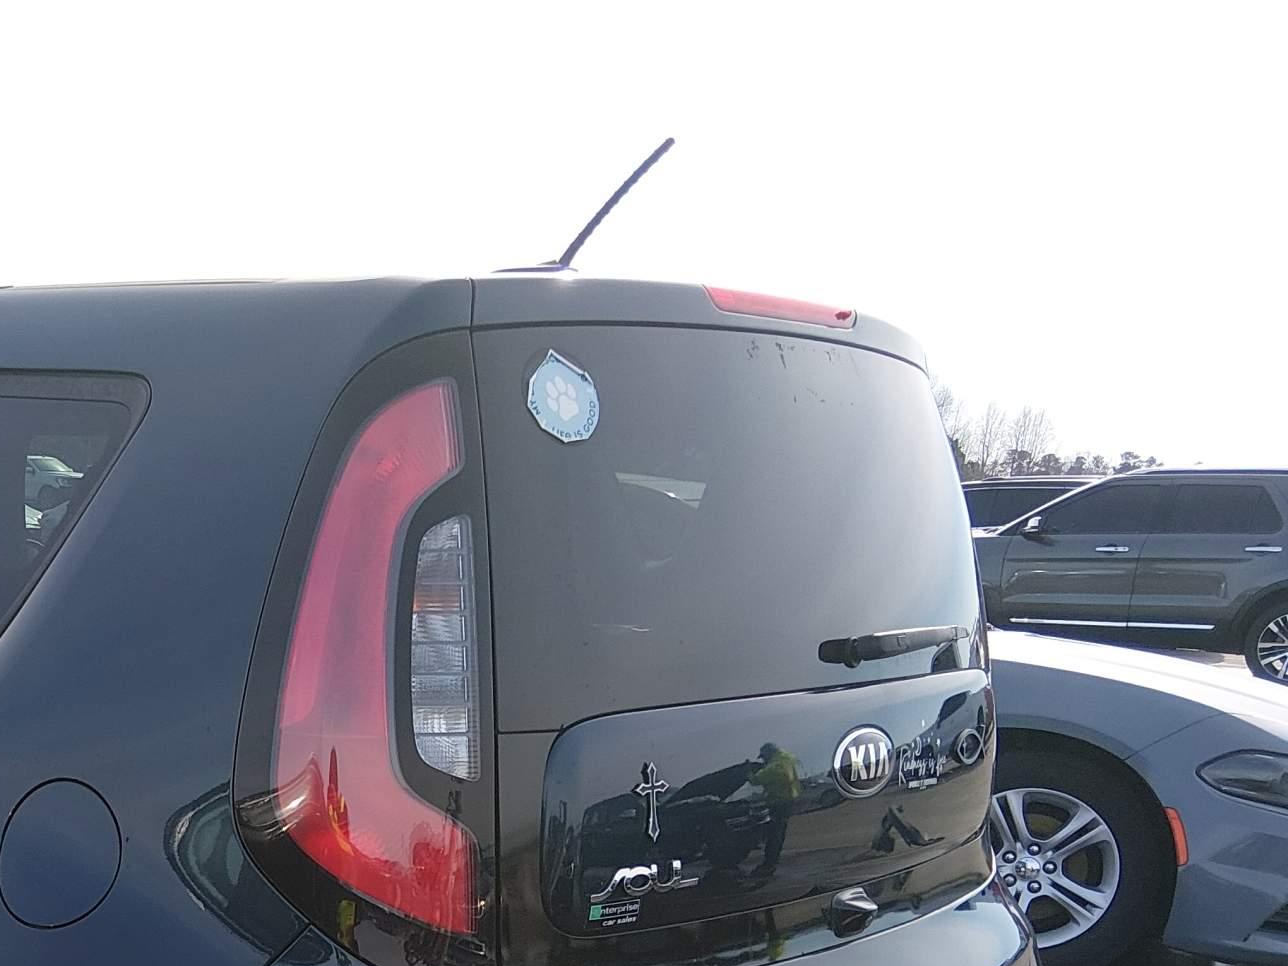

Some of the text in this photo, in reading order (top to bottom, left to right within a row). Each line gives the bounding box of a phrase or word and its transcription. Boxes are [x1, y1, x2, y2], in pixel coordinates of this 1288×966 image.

[583, 400, 596, 433] GOOD
[848, 741, 891, 782] KIA
[602, 915, 637, 927] car sales
